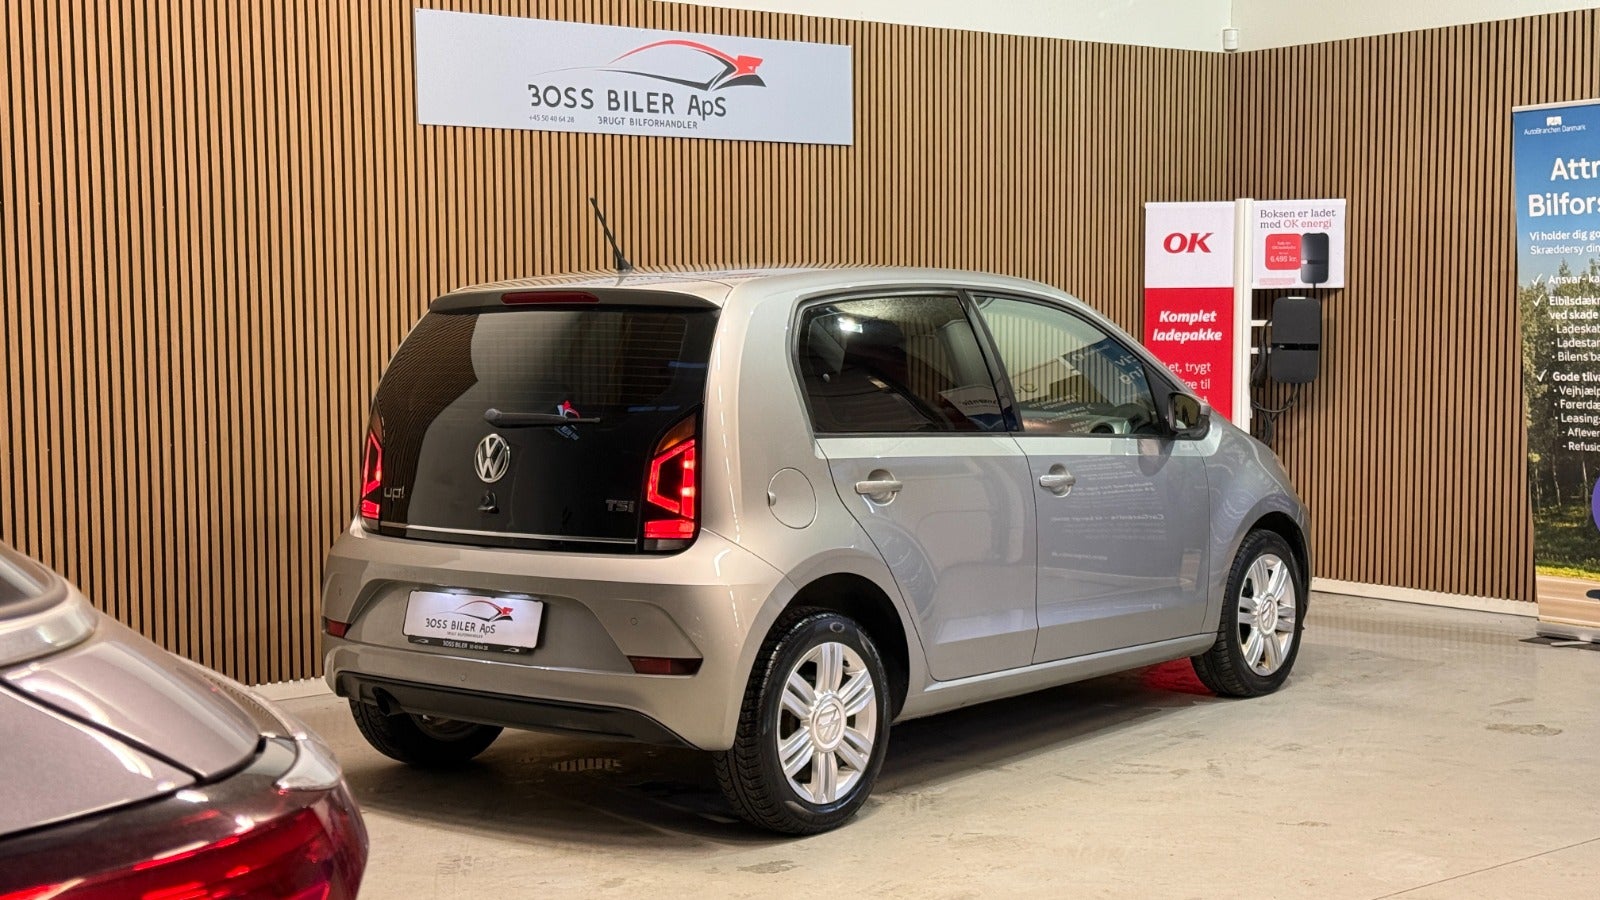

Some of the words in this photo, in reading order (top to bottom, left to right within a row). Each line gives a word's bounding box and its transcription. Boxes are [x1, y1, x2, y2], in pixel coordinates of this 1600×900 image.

[607, 89, 675, 115] BILER
[687, 94, 727, 121] ApS
[629, 117, 699, 130] BILFORHANDLER
[1562, 125, 1587, 133] Danmark
[1550, 157, 1600, 181] Attr
[1528, 191, 1600, 218] Bilfor
[1260, 209, 1296, 219] Boksen
[1310, 209, 1337, 218] ladet
[1260, 219, 1282, 229] med
[1284, 219, 1300, 229] OK
[1301, 218, 1332, 230] energi
[1529, 231, 1540, 241] Vi
[1541, 230, 1571, 241] holder
[1572, 229, 1588, 242] dig
[1163, 232, 1215, 254] OK
[1530, 245, 1584, 256] Skræddersy
[1548, 275, 1586, 285] Ansvar-
[1159, 309, 1218, 326] Komplet
[1550, 310, 1568, 320] ved
[1569, 309, 1599, 320] skade
[1152, 328, 1223, 344] ladepakke
[1558, 351, 1589, 362] Bilens
[1185, 362, 1211, 375] trygt
[1552, 371, 1580, 382] Gode
[1200, 378, 1211, 390] til
[1561, 413, 1600, 426] Leasing
[383, 485, 405, 502] up!
[450, 620, 476, 632] BILER
[479, 623, 497, 636] ApS
